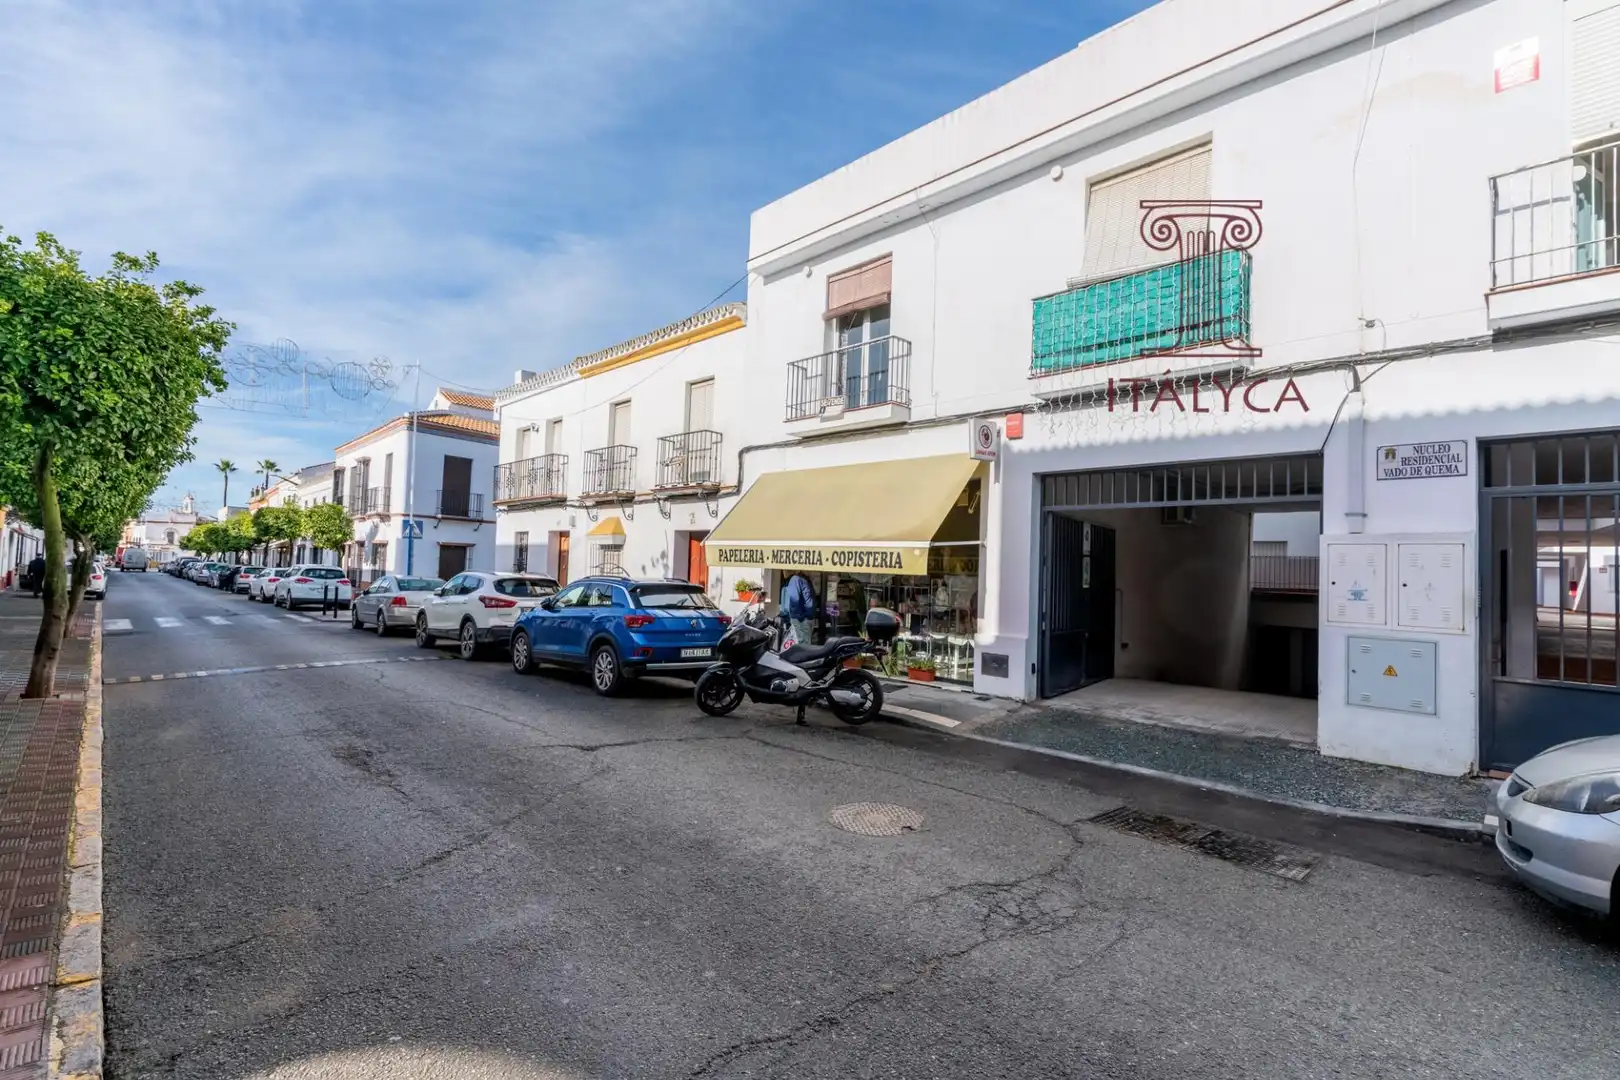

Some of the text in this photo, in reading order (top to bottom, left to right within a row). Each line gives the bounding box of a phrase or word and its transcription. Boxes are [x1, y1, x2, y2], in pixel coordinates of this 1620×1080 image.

[1412, 444, 1451, 455] NUCLEO
[1400, 453, 1463, 466] RESIDENCIAL
[1383, 464, 1460, 477] VADO DE QUEMA
[718, 548, 903, 569] PAPELERIA MERCERIA COPISTERIA
